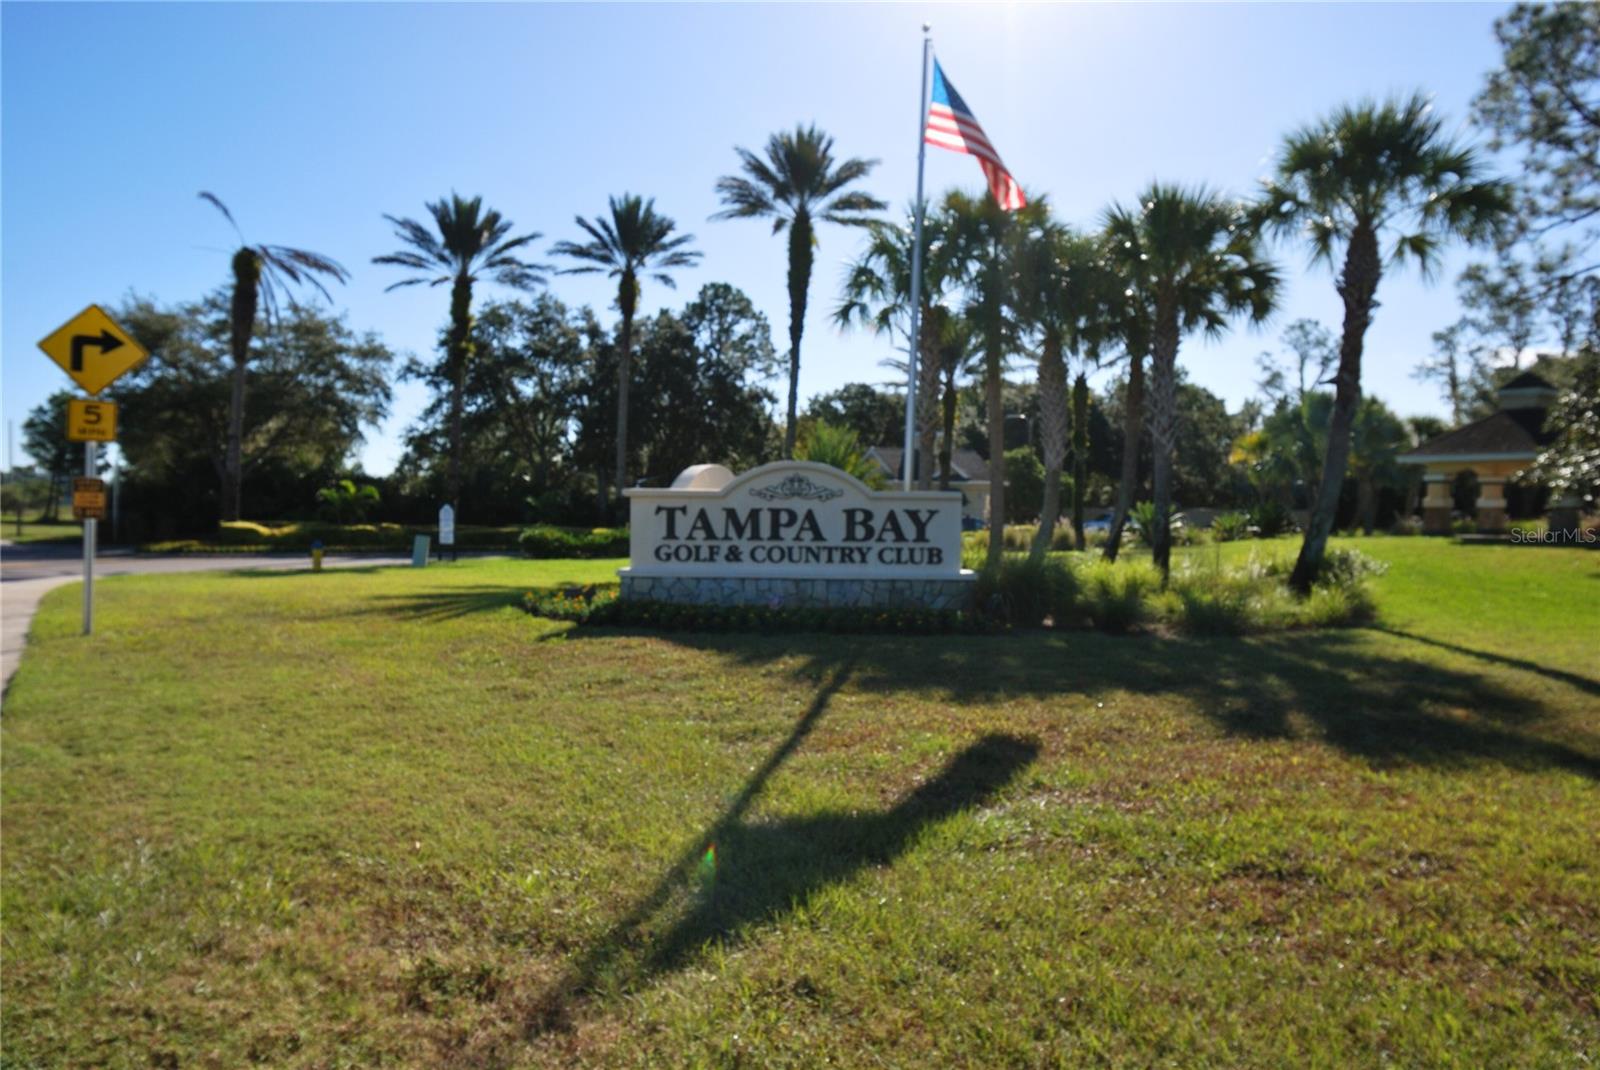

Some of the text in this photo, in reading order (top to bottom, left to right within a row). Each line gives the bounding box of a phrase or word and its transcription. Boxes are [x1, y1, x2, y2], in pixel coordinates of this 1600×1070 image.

[84, 404, 102, 424] 5
[655, 505, 940, 543] TAMPA BAY
[654, 544, 944, 565] GOLF & COUNTRY CLUB
